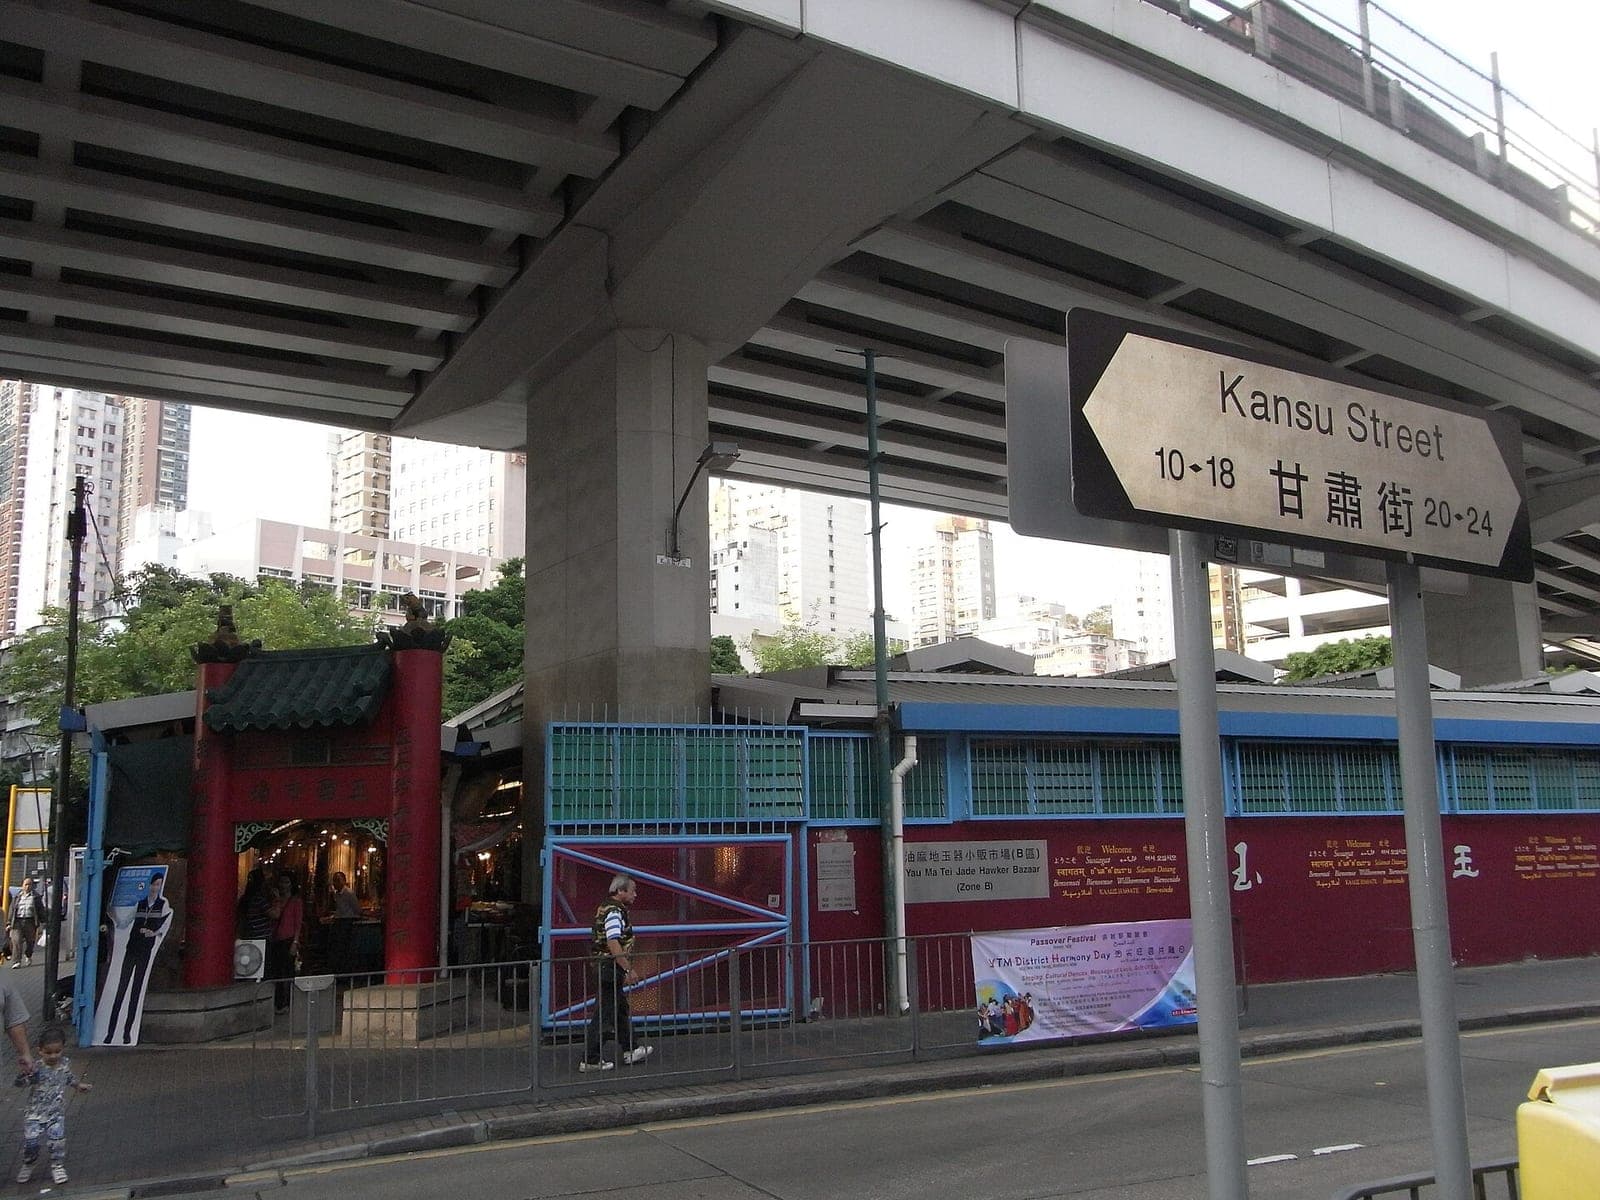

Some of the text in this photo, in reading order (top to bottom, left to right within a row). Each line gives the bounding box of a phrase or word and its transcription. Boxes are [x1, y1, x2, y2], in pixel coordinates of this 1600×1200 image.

[1219, 370, 1444, 461] Kansu Street
[1269, 459, 1413, 538] 甘肅街
[1101, 845, 1132, 854] Welcome
[906, 864, 1040, 878] Yau Ma Tei Jade Hawker Bazaar
[956, 881, 994, 893] (Zone B)
[1030, 936, 1065, 946] Passover
[1066, 935, 1096, 944] Festival
[988, 957, 1012, 968] YTM
[1015, 955, 1049, 967] District
[1052, 953, 1091, 965] Harmony
[1094, 950, 1110, 961] Day
